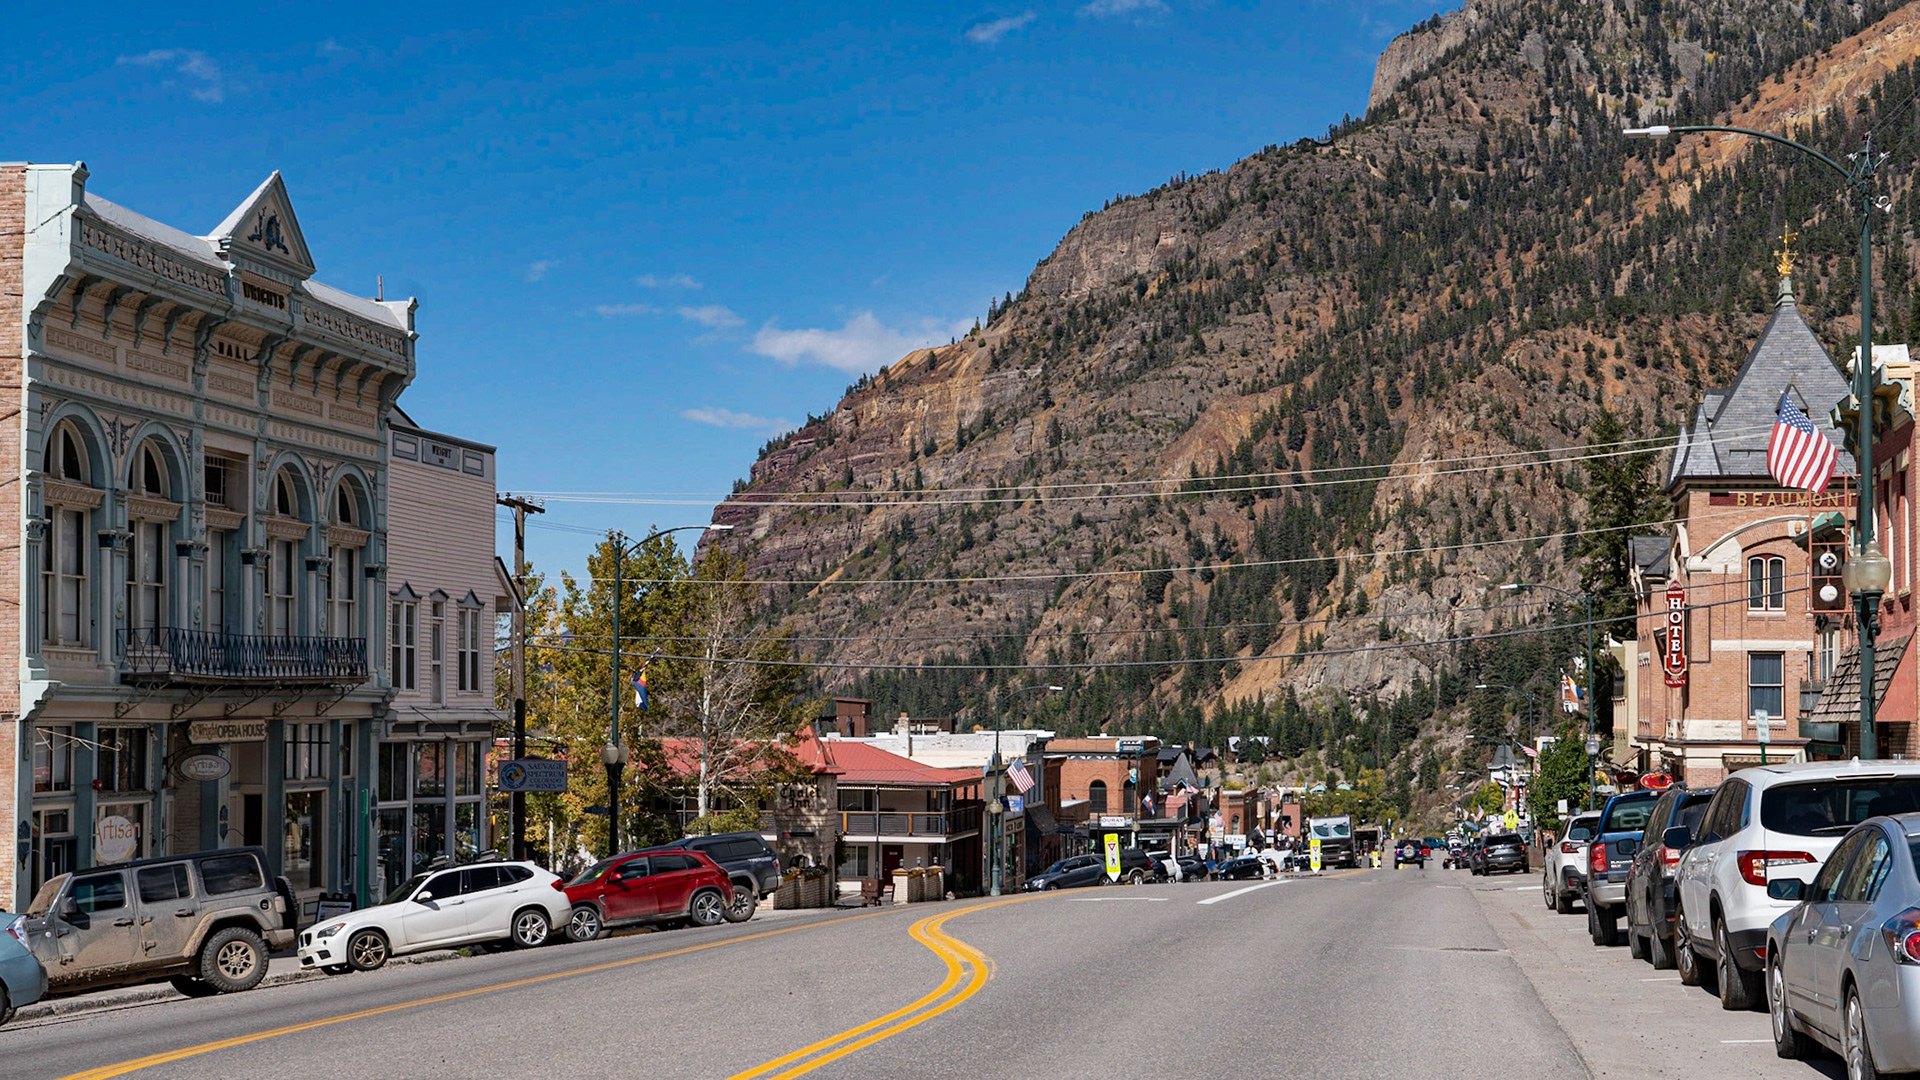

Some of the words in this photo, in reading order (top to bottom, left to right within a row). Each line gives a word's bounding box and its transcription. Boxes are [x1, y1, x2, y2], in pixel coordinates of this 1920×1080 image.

[242, 281, 285, 310] WRIGHTS
[218, 341, 250, 362] HALL
[1737, 492, 1856, 507] BEAUMONT
[1669, 597, 1683, 666] HOTEL
[217, 724, 242, 738] OPERA
[242, 723, 265, 737] HOUSE
[780, 787, 821, 799] Chalet
[789, 798, 811, 808] Inn
[96, 817, 141, 846] Artisan
